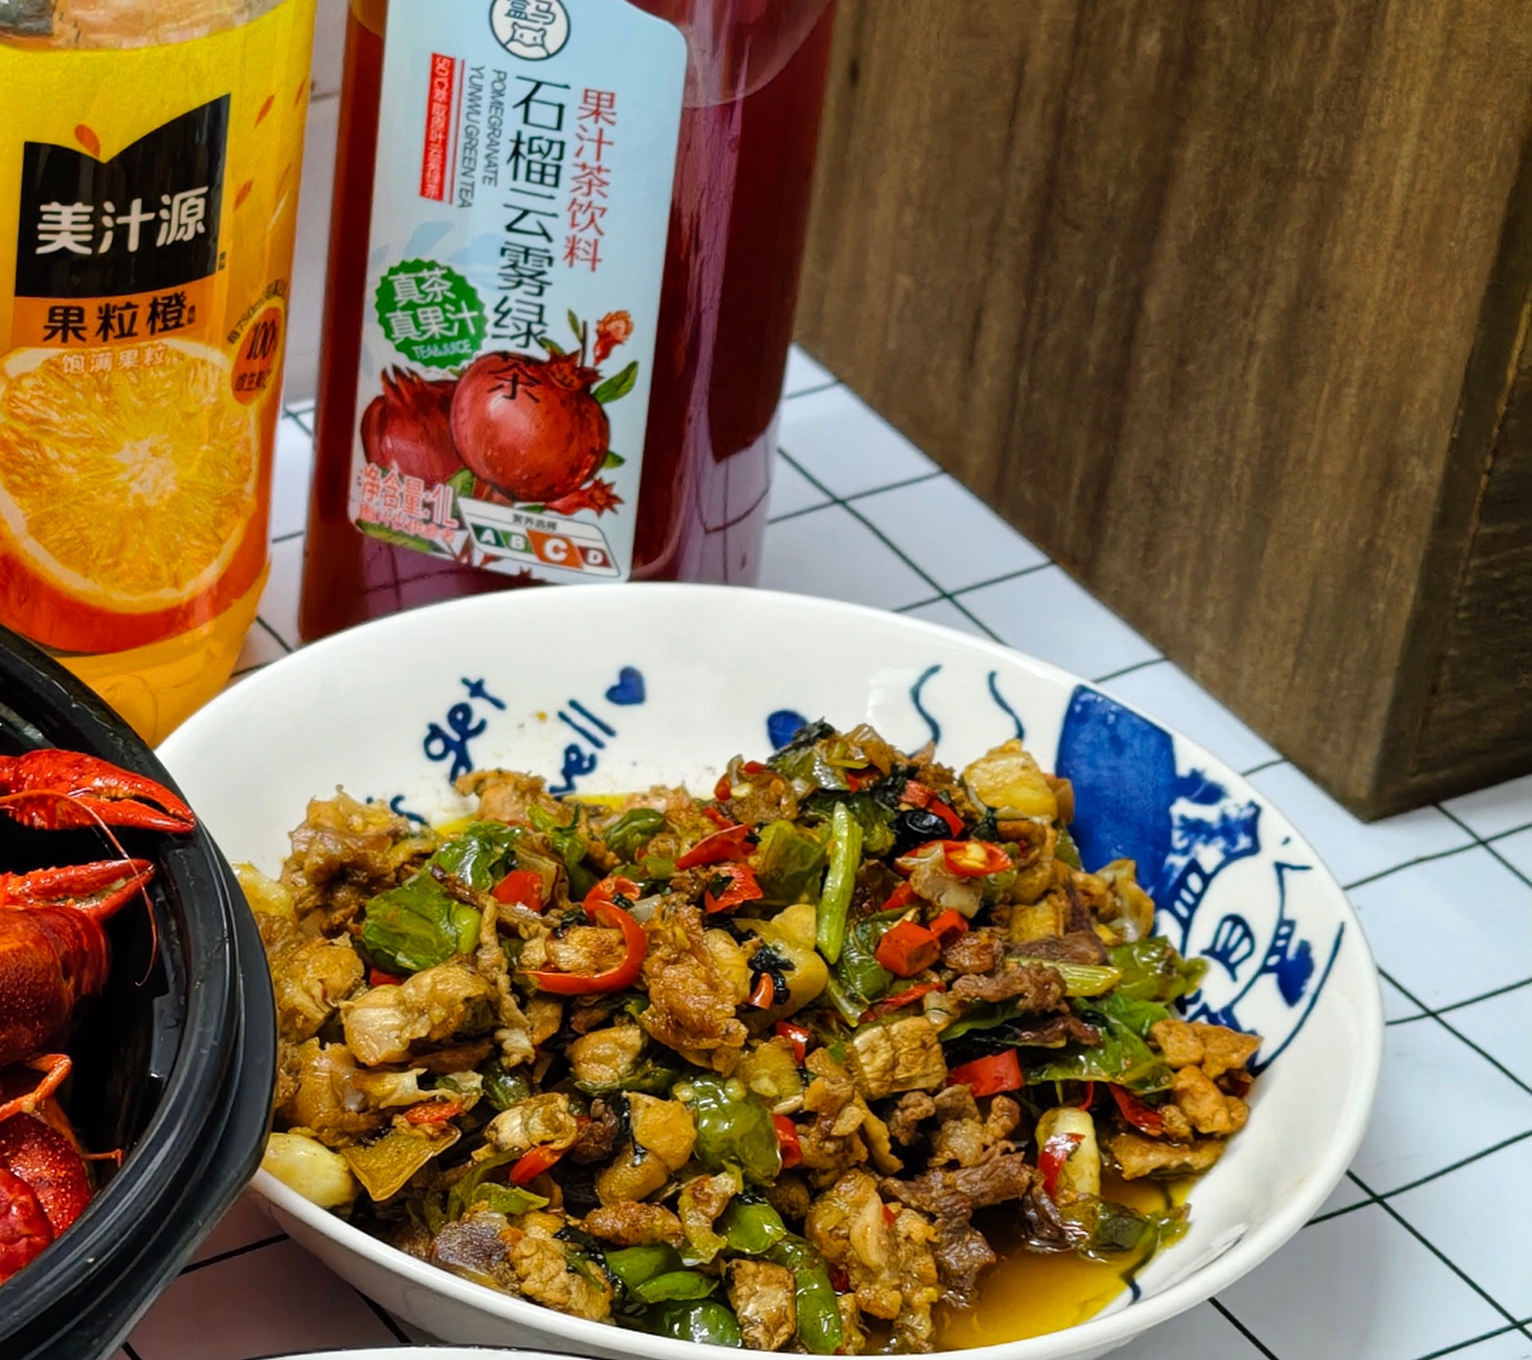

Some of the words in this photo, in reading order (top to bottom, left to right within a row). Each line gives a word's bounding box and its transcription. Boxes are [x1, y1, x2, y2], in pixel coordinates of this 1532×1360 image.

[465, 65, 485, 124] YUNWU
[461, 125, 480, 183] GREEN
[482, 69, 507, 188] POMEGRANATE
[457, 180, 475, 209] TEA
[563, 88, 617, 273] 果汁茶饮料
[35, 186, 209, 255] 美汁源
[487, 75, 571, 402] 石榴云雾绿茶
[388, 267, 457, 307] 真茶
[43, 291, 187, 343] 果粒橙
[385, 300, 479, 344] 真果汁
[62, 344, 167, 374] 饱满果粒
[479, 528, 498, 546] A
[509, 532, 526, 550] B
[544, 538, 568, 562] C
[587, 550, 604, 565] D
[549, 699, 617, 803] ell
